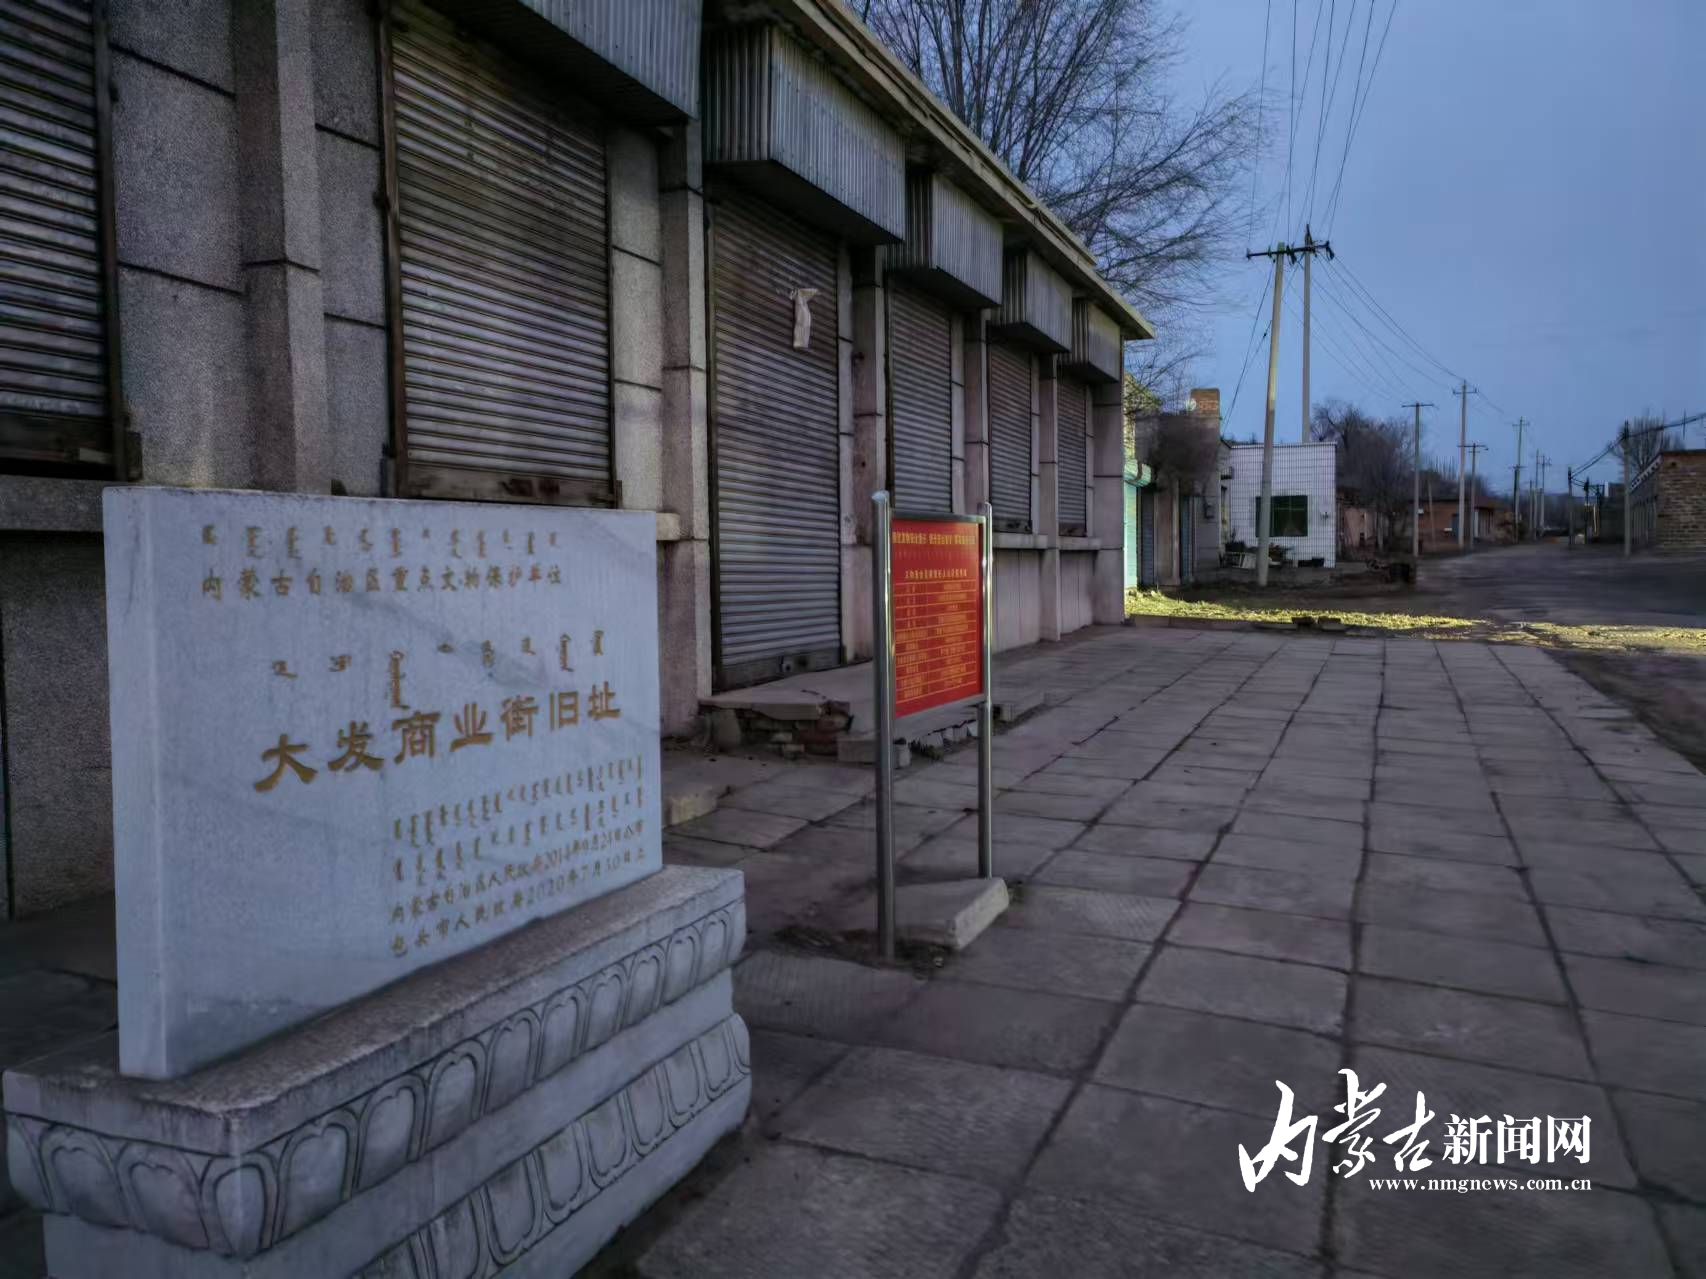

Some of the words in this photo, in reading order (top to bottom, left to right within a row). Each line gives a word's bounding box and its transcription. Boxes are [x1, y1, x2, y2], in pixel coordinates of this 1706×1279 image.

[202, 565, 562, 601] 内蒙古自治区重点文物保护单位
[254, 680, 621, 793] 大发商业街旧址
